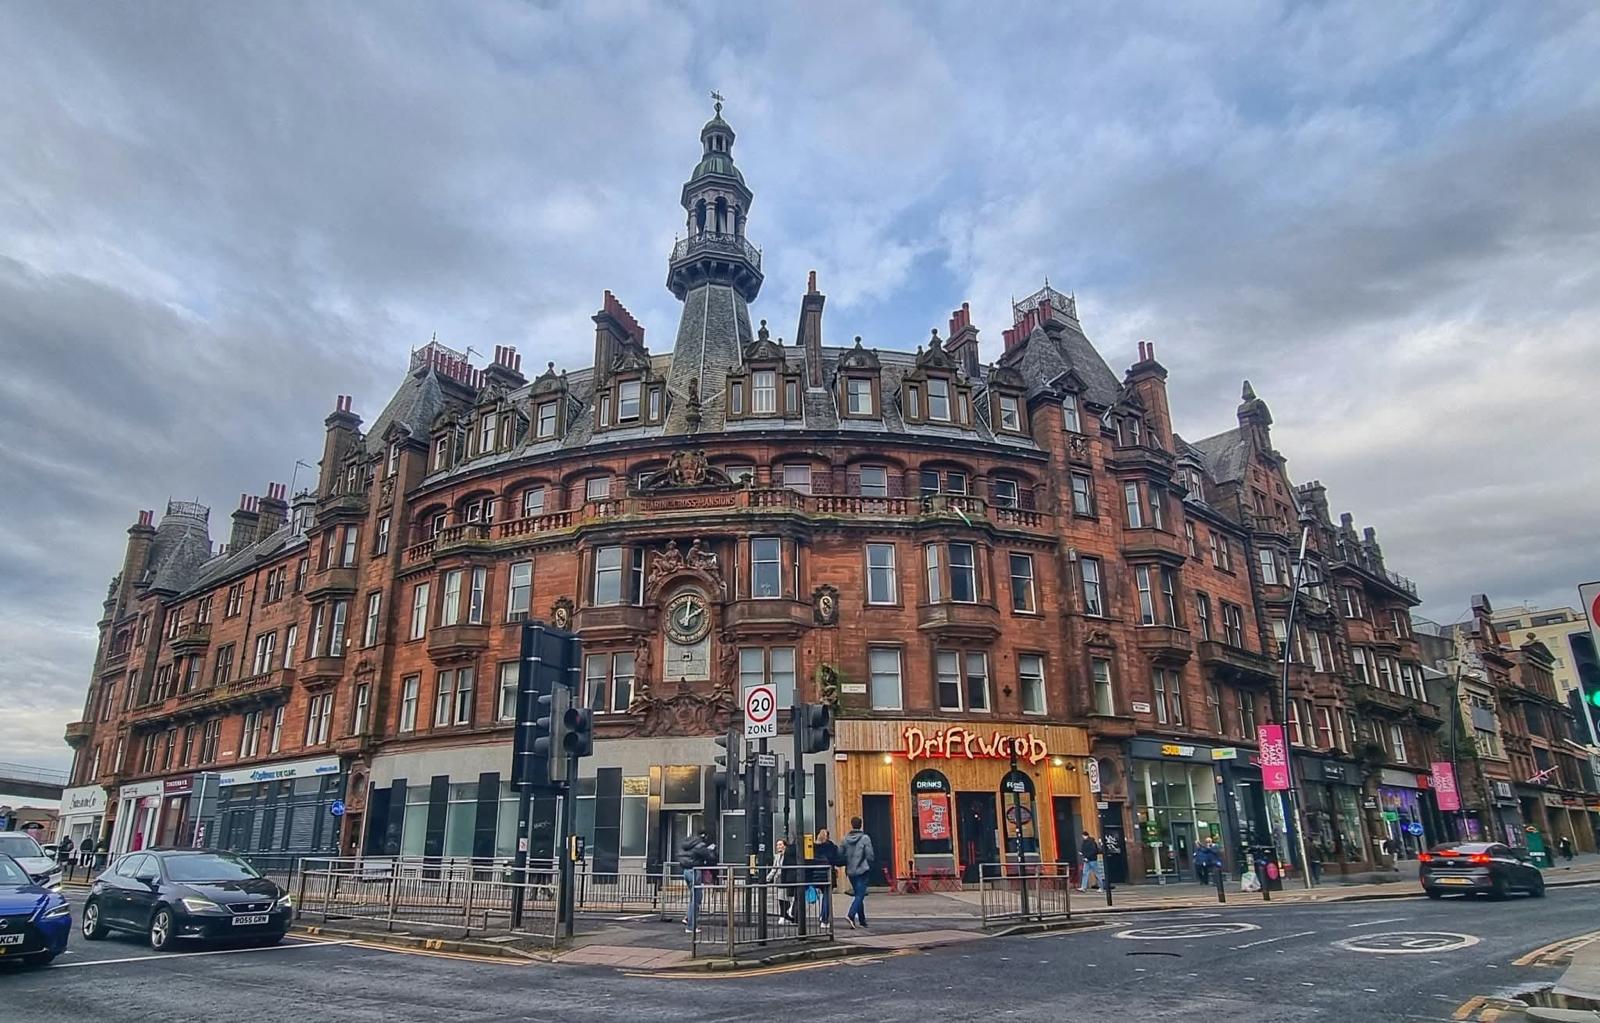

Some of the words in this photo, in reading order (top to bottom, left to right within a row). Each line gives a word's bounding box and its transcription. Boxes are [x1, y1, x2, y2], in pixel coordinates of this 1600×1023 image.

[751, 697, 771, 712] 20
[747, 723, 774, 734] ZONE
[0, 935, 19, 944] KCN
